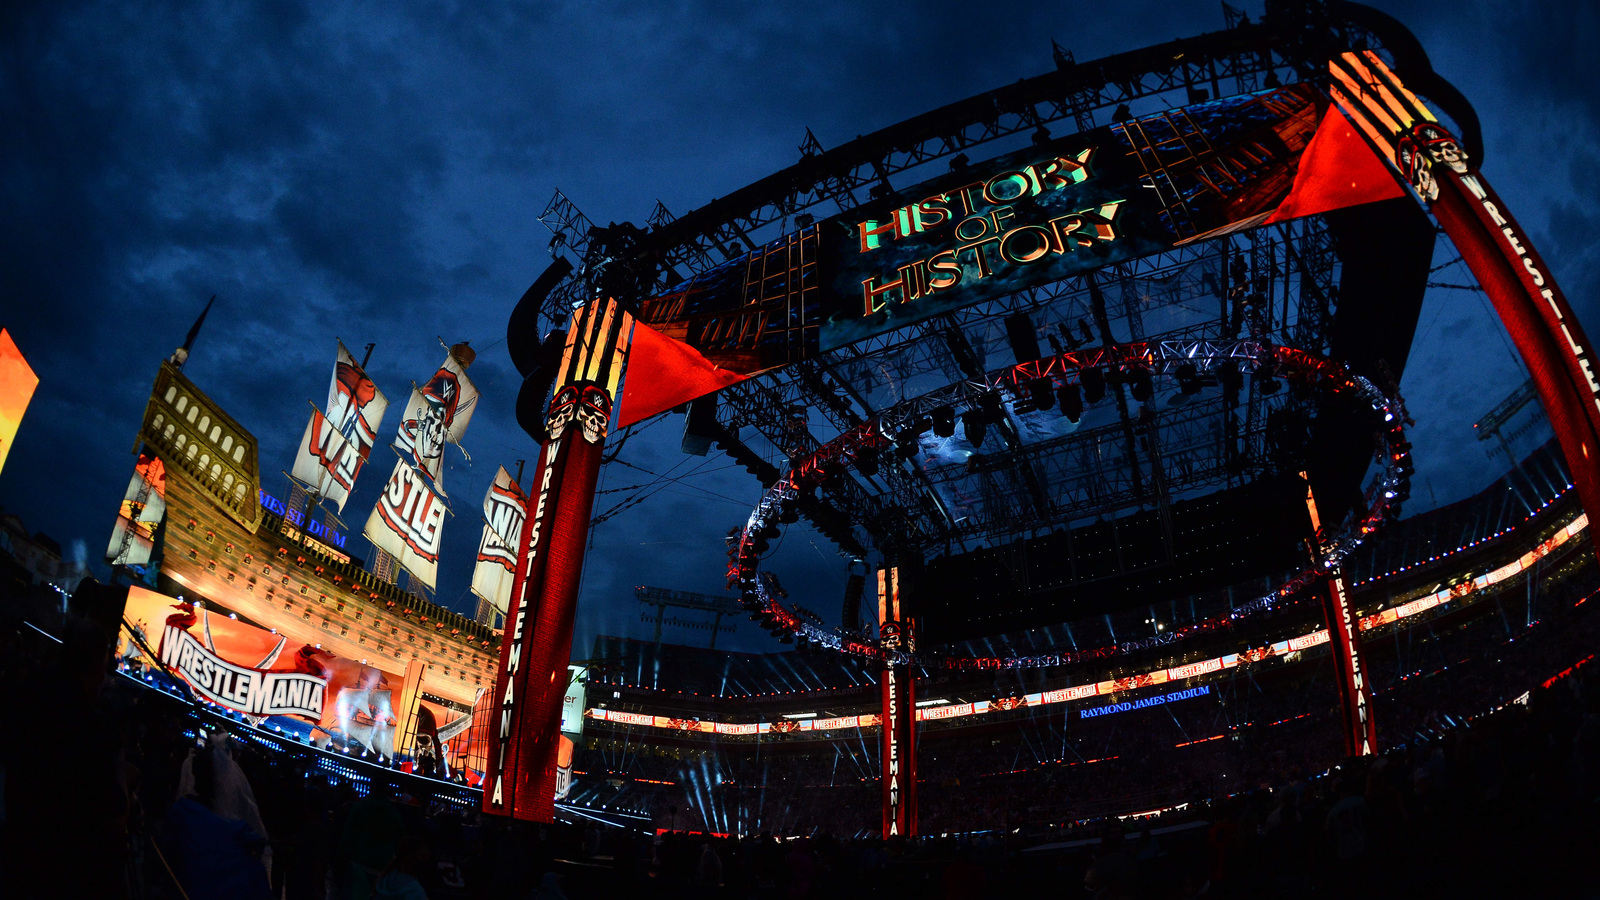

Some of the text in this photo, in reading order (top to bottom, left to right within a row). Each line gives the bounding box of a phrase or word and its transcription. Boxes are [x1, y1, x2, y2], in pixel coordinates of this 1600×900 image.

[857, 146, 1098, 253] HISTORY
[955, 205, 1015, 242] OF
[861, 199, 1127, 317] HISTORY
[388, 464, 443, 542] STLE
[286, 507, 347, 549] STDIUM
[491, 439, 562, 805] WRESTLEMANIA
[162, 625, 324, 715] WRESTLEMANIA
[1168, 658, 1221, 680] WRESTLEMANIA
[1043, 684, 1096, 703] WRESTLEMANIA
[1081, 685, 1210, 719] RAYMOND JAMES STADIUM
[607, 710, 653, 725] WRESTLEMANIA
[715, 723, 757, 734] WRESTLEMANIA
[813, 716, 858, 729] WRESTLEMANIA
[922, 703, 973, 720] WRESTLEMANIA
